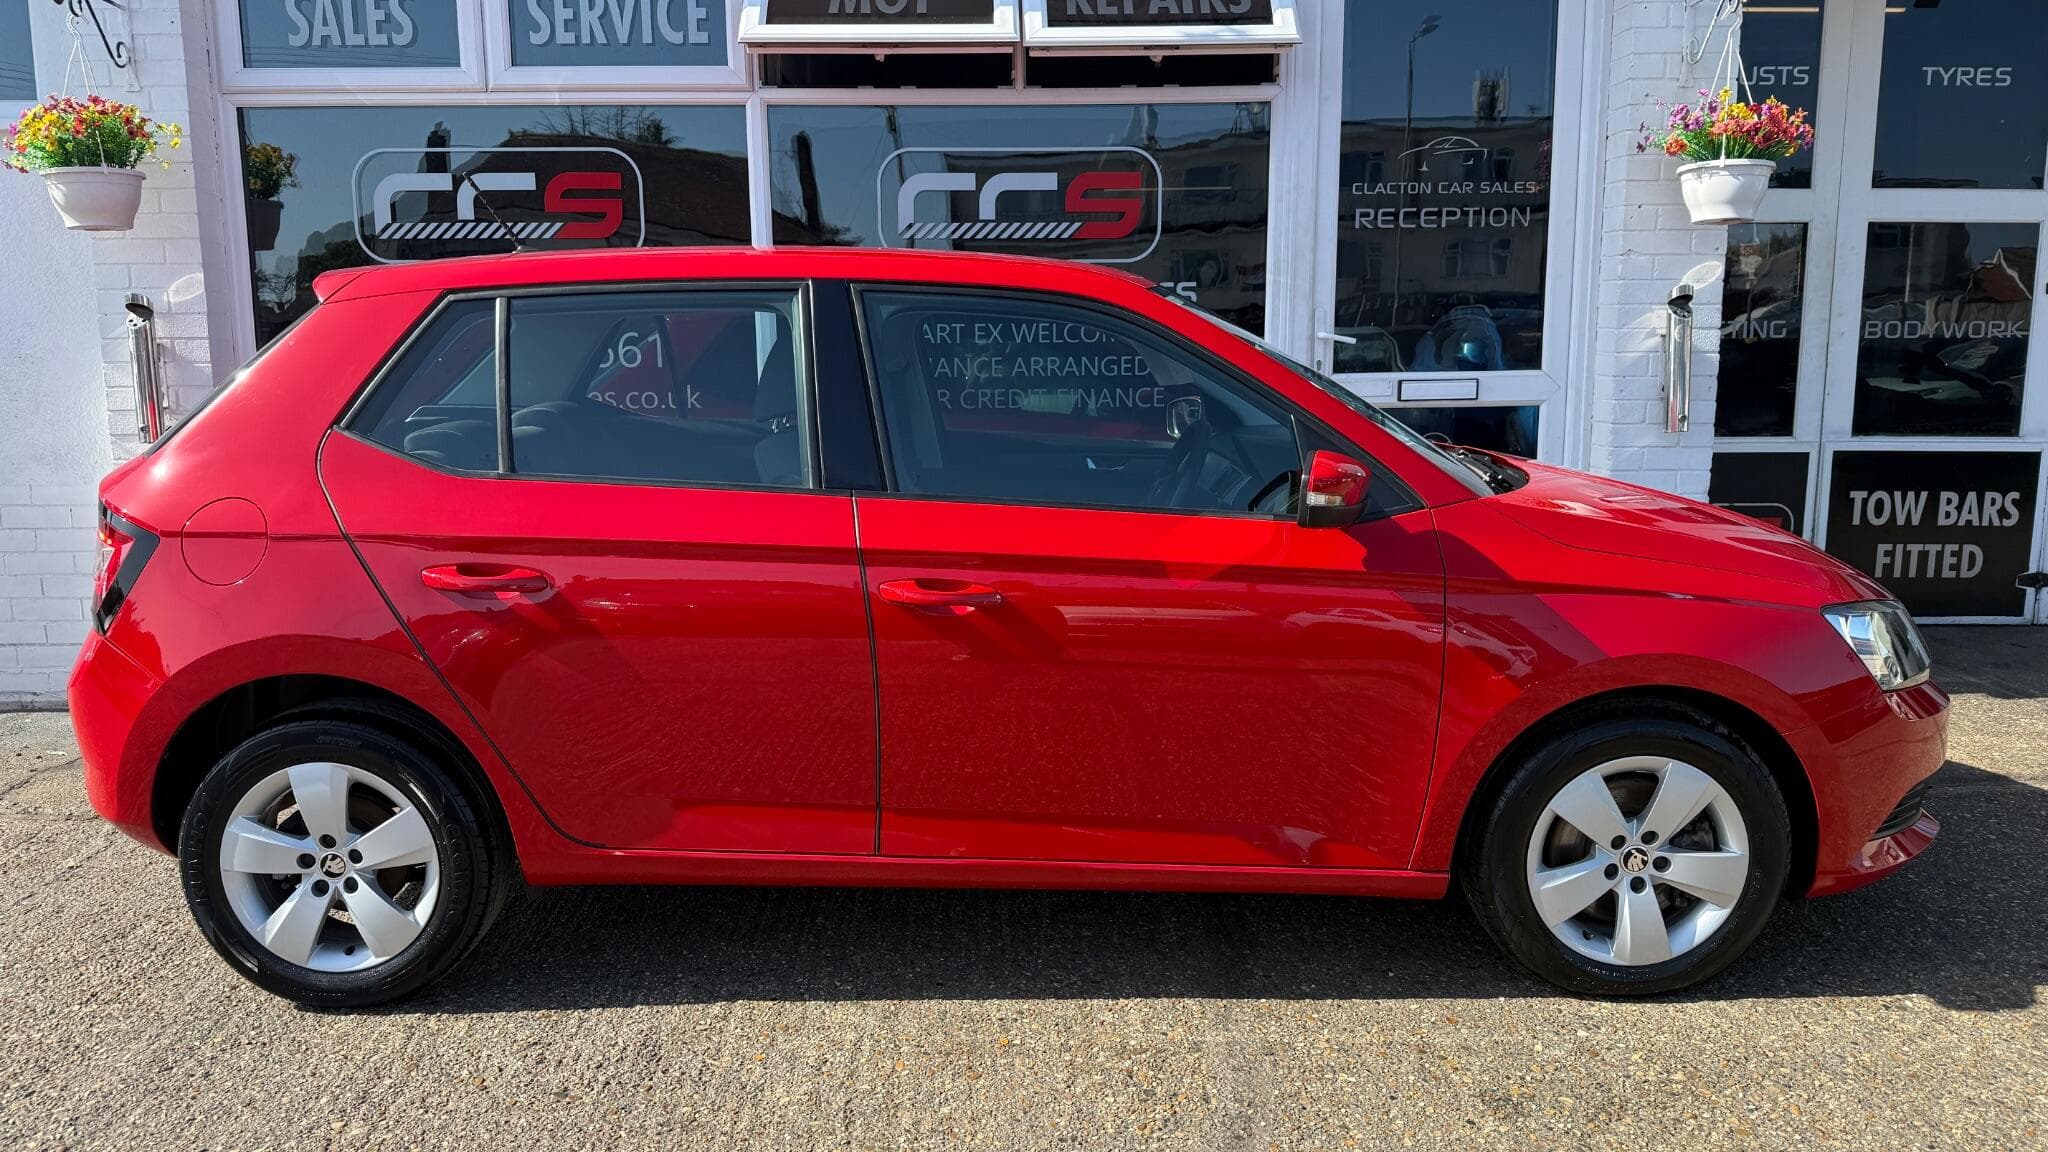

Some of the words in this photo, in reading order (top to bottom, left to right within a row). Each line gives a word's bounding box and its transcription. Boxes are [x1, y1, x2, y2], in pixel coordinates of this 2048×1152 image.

[284, 0, 414, 46] SALES
[526, 0, 710, 45] SERVICE
[1922, 67, 2013, 86] TYRES
[1352, 182, 1431, 195] CLACTON
[1438, 182, 1473, 194] CAR
[1480, 181, 1536, 194] SALES
[1353, 206, 1531, 229] RECEPTION
[974, 323, 1003, 343] EX
[1721, 320, 1787, 339] TING
[1864, 320, 2025, 339] BODYWORK
[930, 356, 1003, 377] ANCE
[1011, 356, 1151, 377] ARRANGED
[960, 388, 1048, 409] CREDIT
[1057, 387, 1165, 408] FINANCE
[1849, 490, 1928, 526] TOW
[1937, 491, 2021, 527] BARS
[1874, 543, 1984, 578] FITTED
